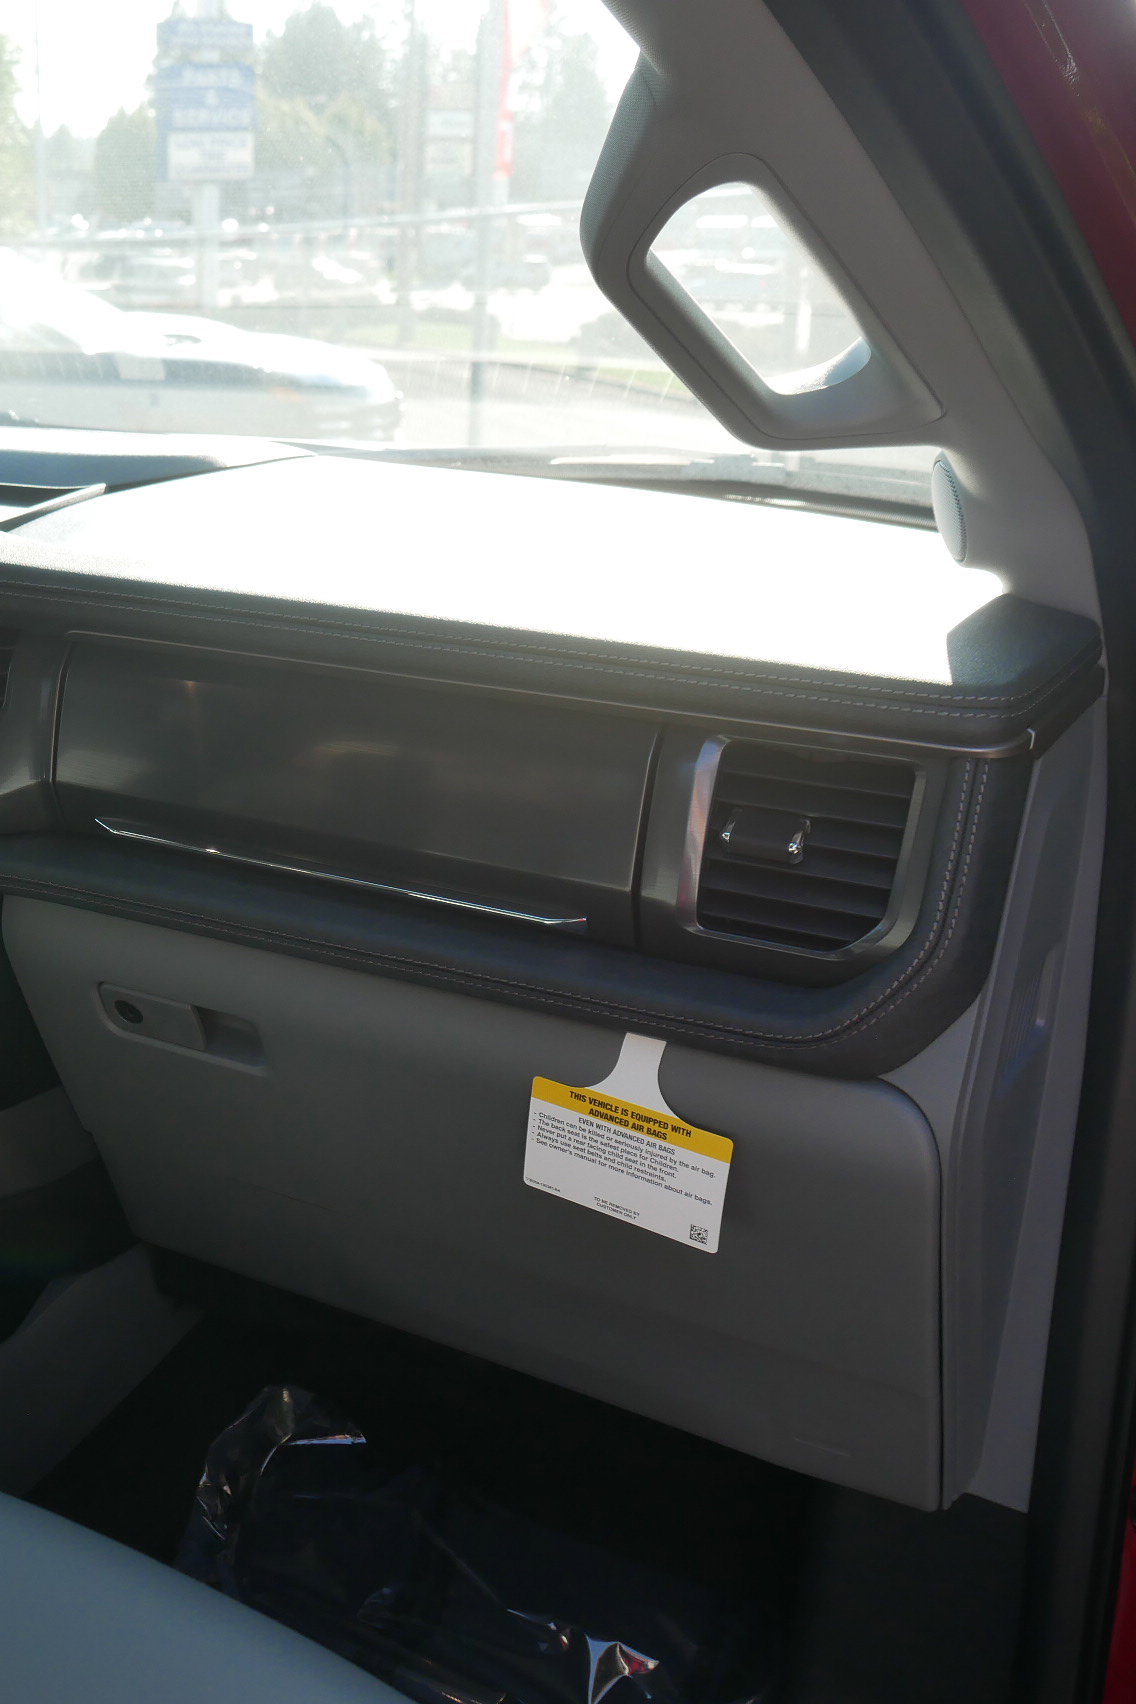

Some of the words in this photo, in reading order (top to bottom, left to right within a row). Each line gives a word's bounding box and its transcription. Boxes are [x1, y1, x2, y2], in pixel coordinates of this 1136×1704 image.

[569, 1091, 587, 1103] THIS
[588, 1097, 619, 1114] VEHICLE
[621, 1107, 629, 1117] IS
[631, 1111, 669, 1130] EQUIPPED
[671, 1124, 692, 1138] WITH
[578, 1117, 594, 1128] EVEN
[595, 1123, 611, 1134] WITH
[613, 1129, 645, 1145] ADVANCED
[646, 1140, 657, 1149] AIR
[658, 1144, 676, 1155] BAGS
[588, 1108, 629, 1128] ADVANCED
[631, 1122, 644, 1133] AIR
[647, 1127, 668, 1140] BAGS
[536, 1132, 559, 1145] Always
[573, 1144, 586, 1153] seat
[587, 1149, 602, 1159] belts
[604, 1155, 616, 1164] and
[617, 1160, 633, 1170] child
[634, 1166, 667, 1182] restraints.
[537, 1125, 555, 1136] Never
[556, 1132, 567, 1141] put
[587, 1142, 606, 1155] facing
[607, 1149, 624, 1160] child
[625, 1155, 638, 1165] seat
[647, 1163, 658, 1172] the
[659, 1167, 677, 1178] front.
[538, 1119, 549, 1127] The
[551, 1123, 565, 1133] back
[567, 1129, 580, 1138] seat
[588, 1136, 599, 1144] the
[600, 1140, 619, 1151] safest
[620, 1147, 638, 1160] place
[639, 1154, 648, 1162] for
[649, 1157, 679, 1172] Children.
[539, 1112, 565, 1125] Children
[588, 1129, 605, 1139] killed
[614, 1138, 643, 1154] seriously
[669, 1157, 678, 1166] by
[679, 1160, 690, 1169] the
[691, 1164, 700, 1172] air
[701, 1168, 716, 1179] bag.
[536, 1138, 547, 1146] See
[549, 1143, 573, 1155] owner's
[574, 1151, 597, 1164] manual
[598, 1160, 607, 1168] for
[609, 1165, 624, 1174] more
[664, 1183, 683, 1195] about
[694, 1194, 713, 1207] bags.
